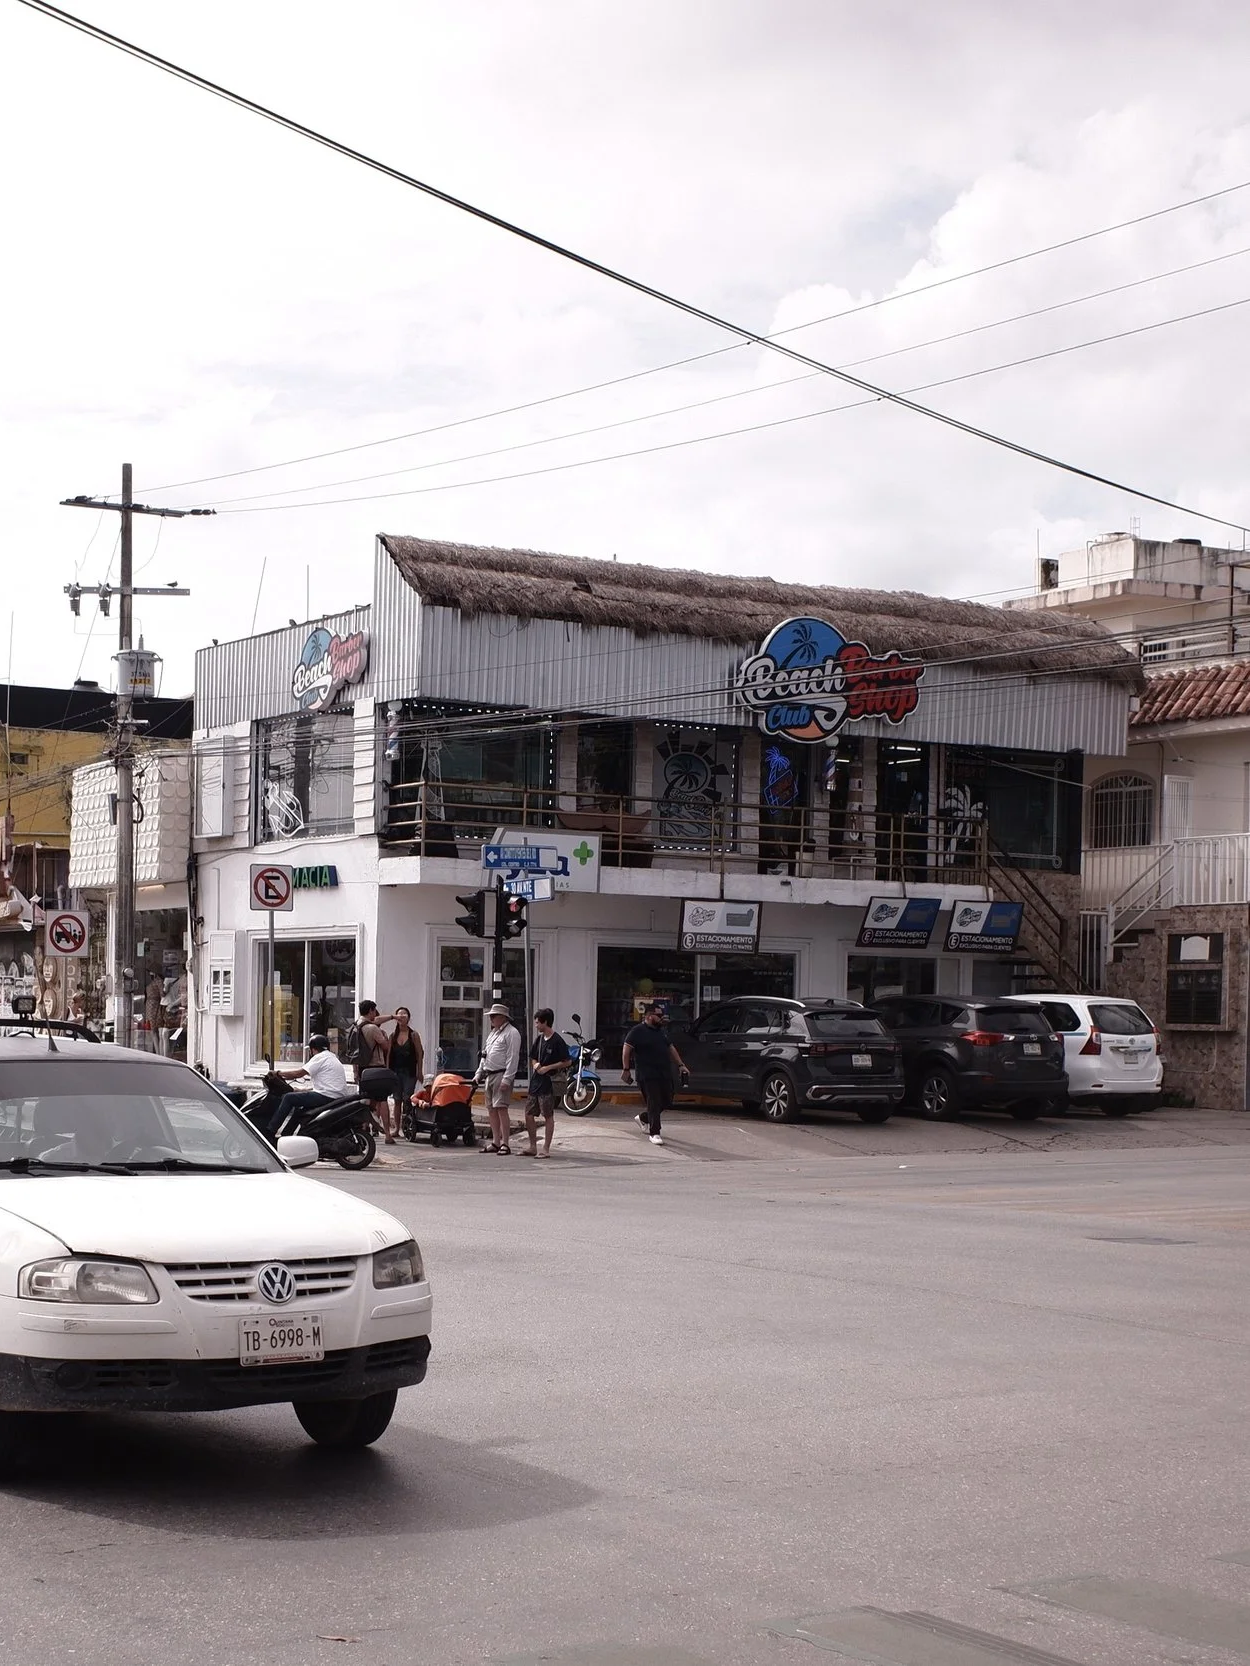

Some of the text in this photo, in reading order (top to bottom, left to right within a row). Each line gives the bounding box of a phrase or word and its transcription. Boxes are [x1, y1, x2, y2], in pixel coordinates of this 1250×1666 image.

[330, 632, 363, 664] Barber
[839, 644, 922, 683] Barber
[293, 652, 333, 691] Beach
[333, 651, 360, 684] Shop
[743, 657, 846, 699] Beach
[767, 704, 811, 729] Club
[849, 683, 918, 720] Shop
[293, 865, 331, 888] MACIA
[961, 935, 1013, 944] ESTACIONAMIENTO
[243, 1326, 321, 1351] TB-6998-M
